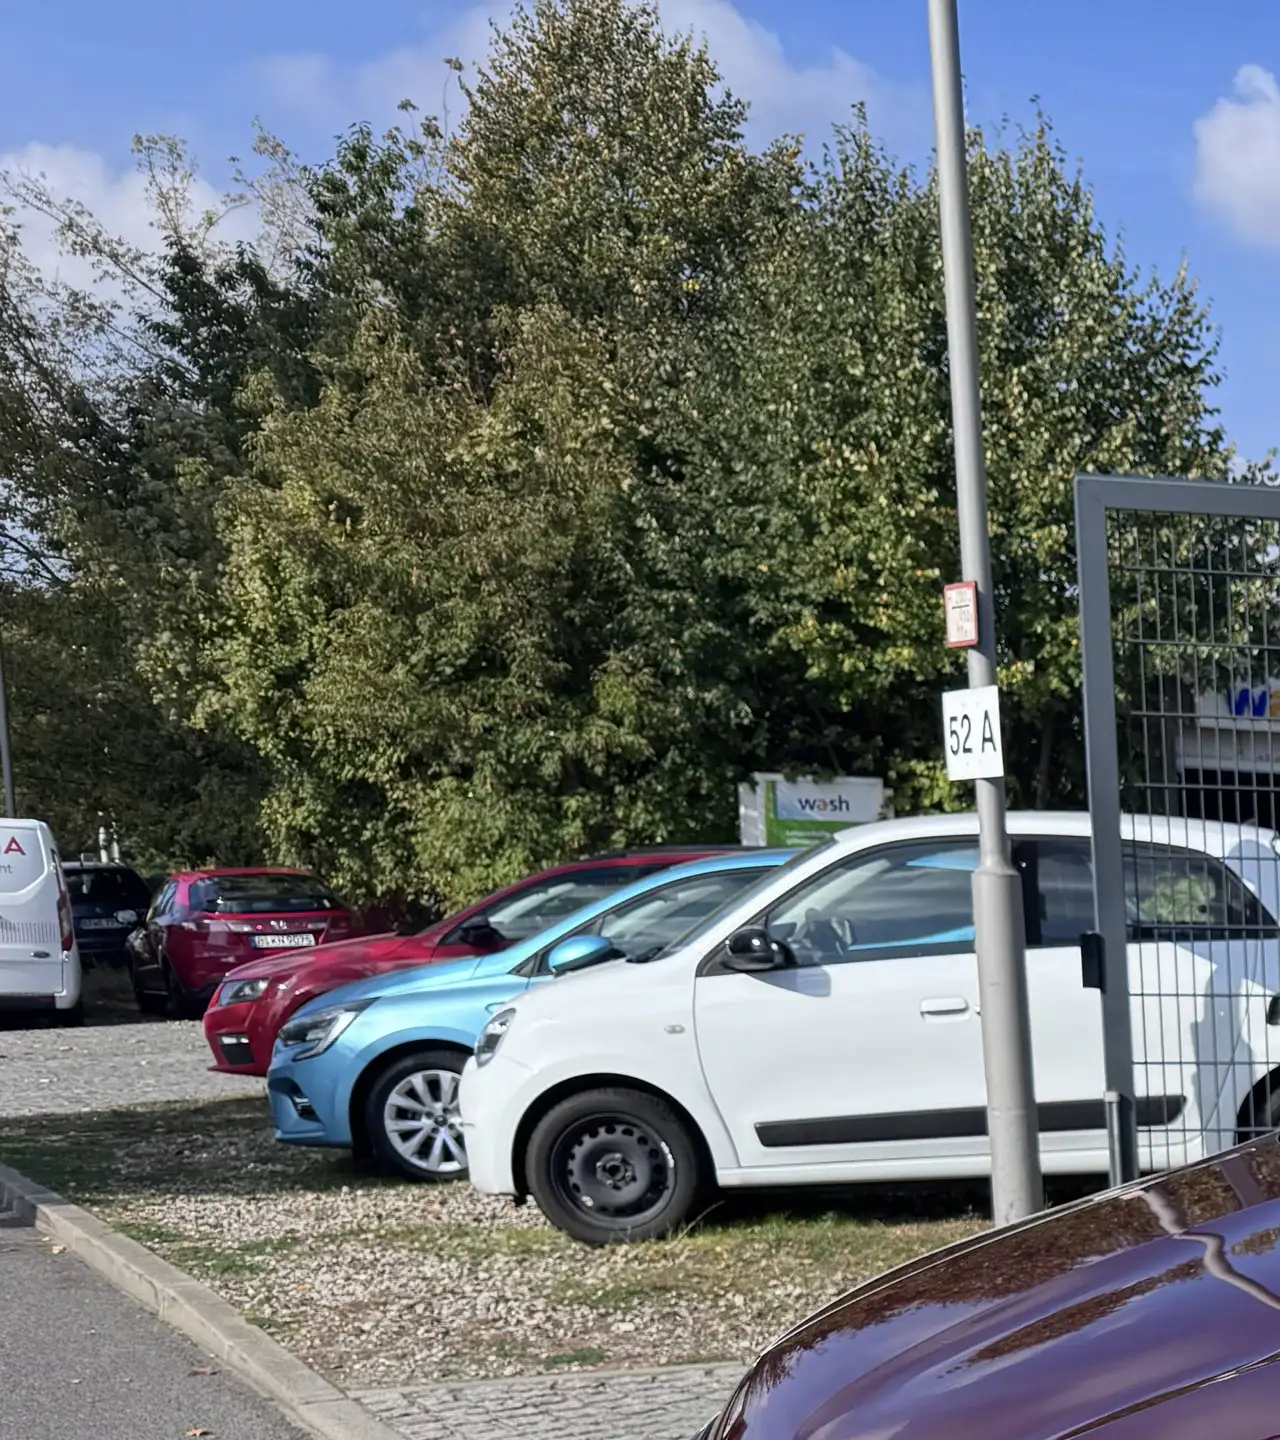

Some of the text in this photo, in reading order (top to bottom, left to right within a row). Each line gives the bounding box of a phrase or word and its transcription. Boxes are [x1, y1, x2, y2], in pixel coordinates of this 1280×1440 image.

[950, 709, 997, 756] 52 A
[798, 795, 850, 812] wash
